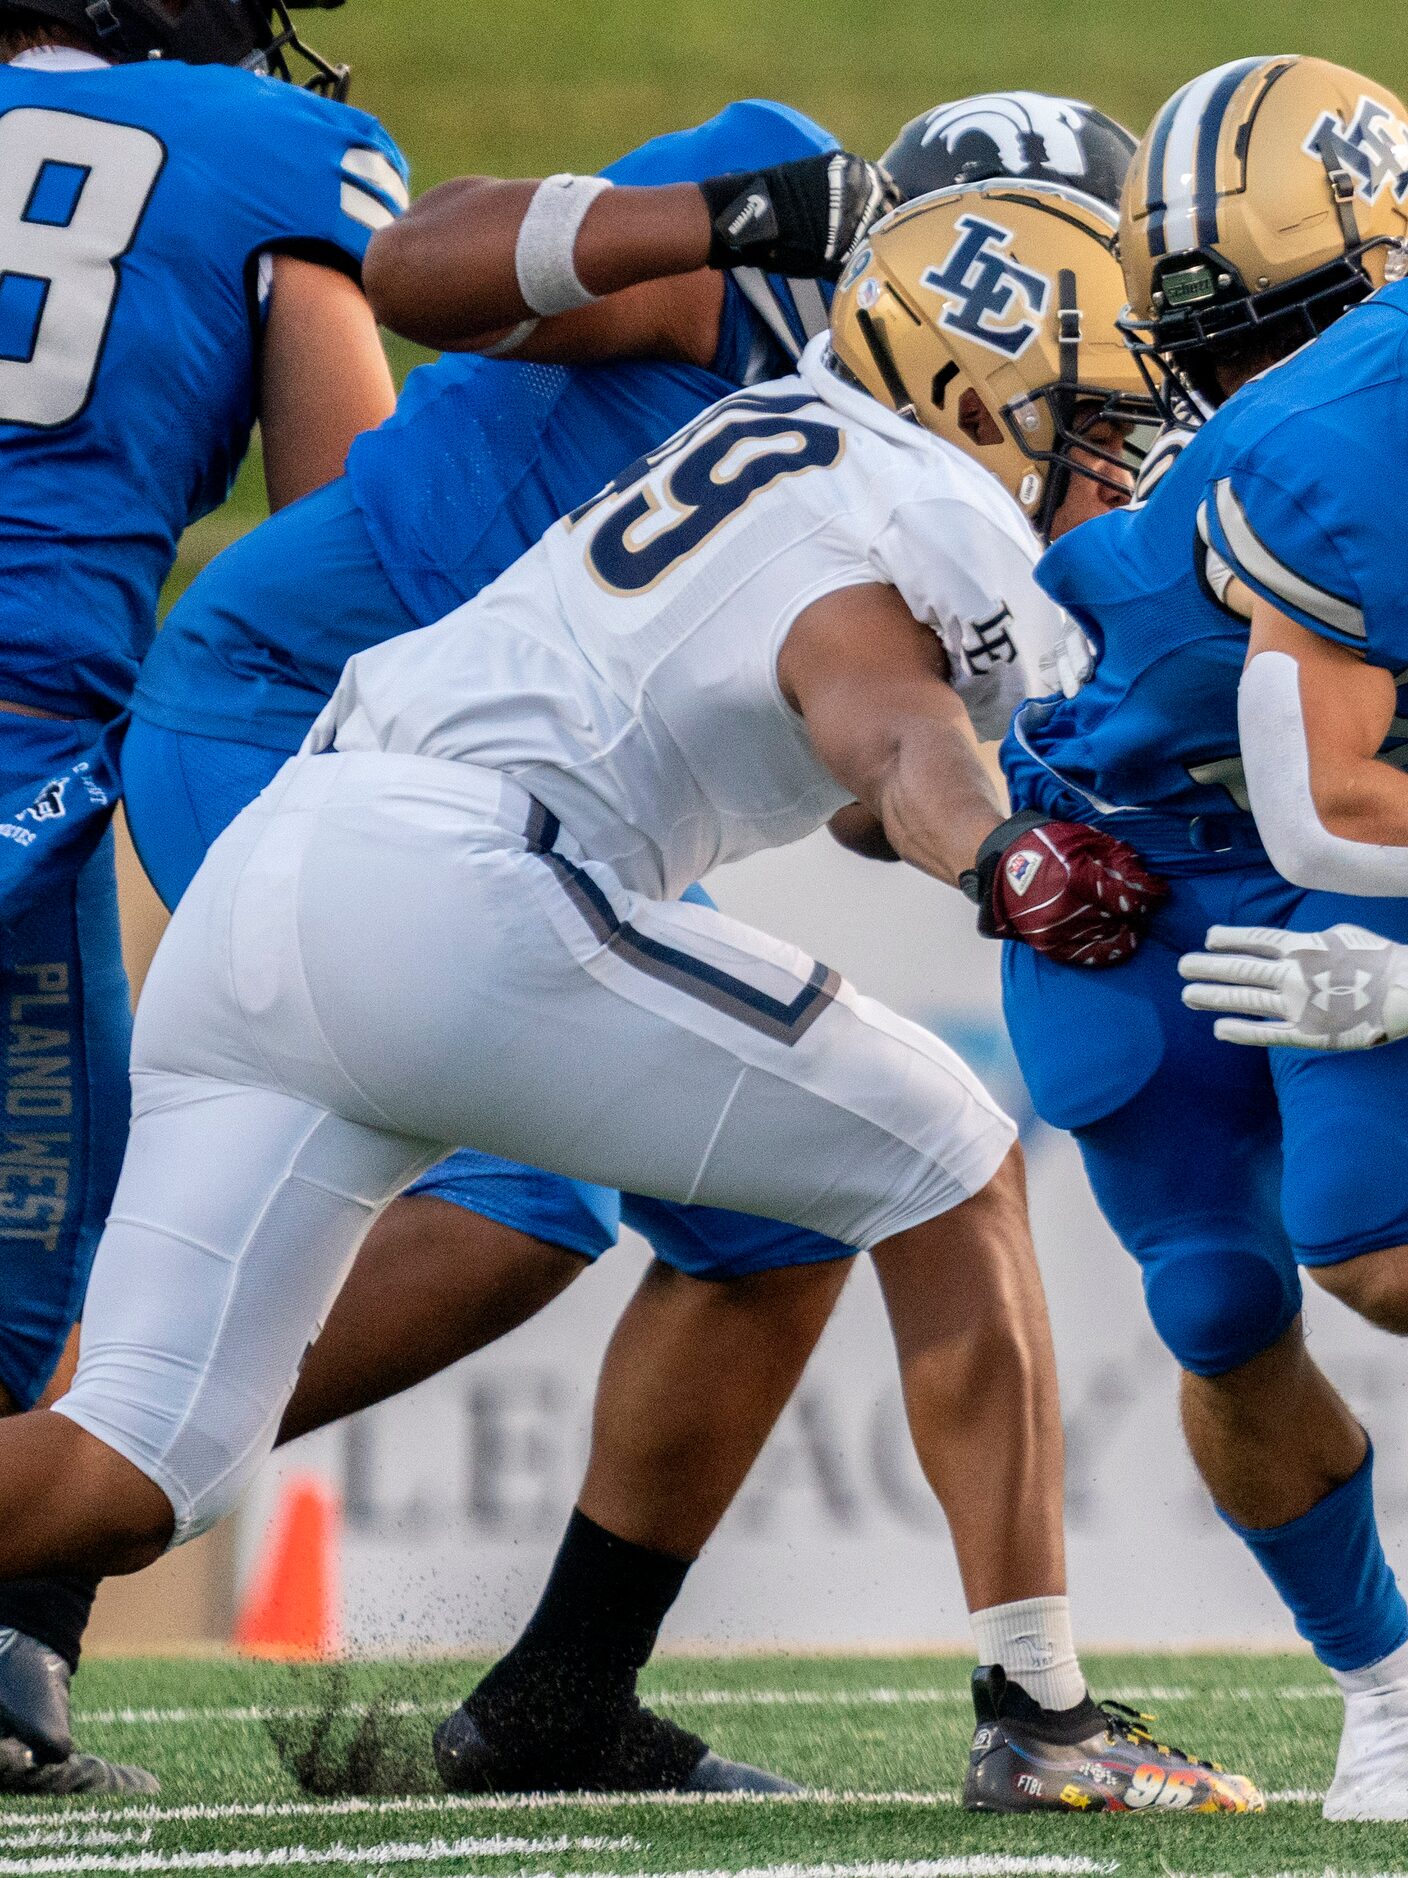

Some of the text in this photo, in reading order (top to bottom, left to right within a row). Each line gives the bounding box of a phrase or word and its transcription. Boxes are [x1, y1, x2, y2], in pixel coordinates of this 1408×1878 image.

[921, 214, 1053, 361] LE
[560, 392, 846, 598] 9
[0, 962, 73, 1252] PLANO WEST
[1017, 1775, 1042, 1797] FTBL
[1123, 1763, 1198, 1808] 96
